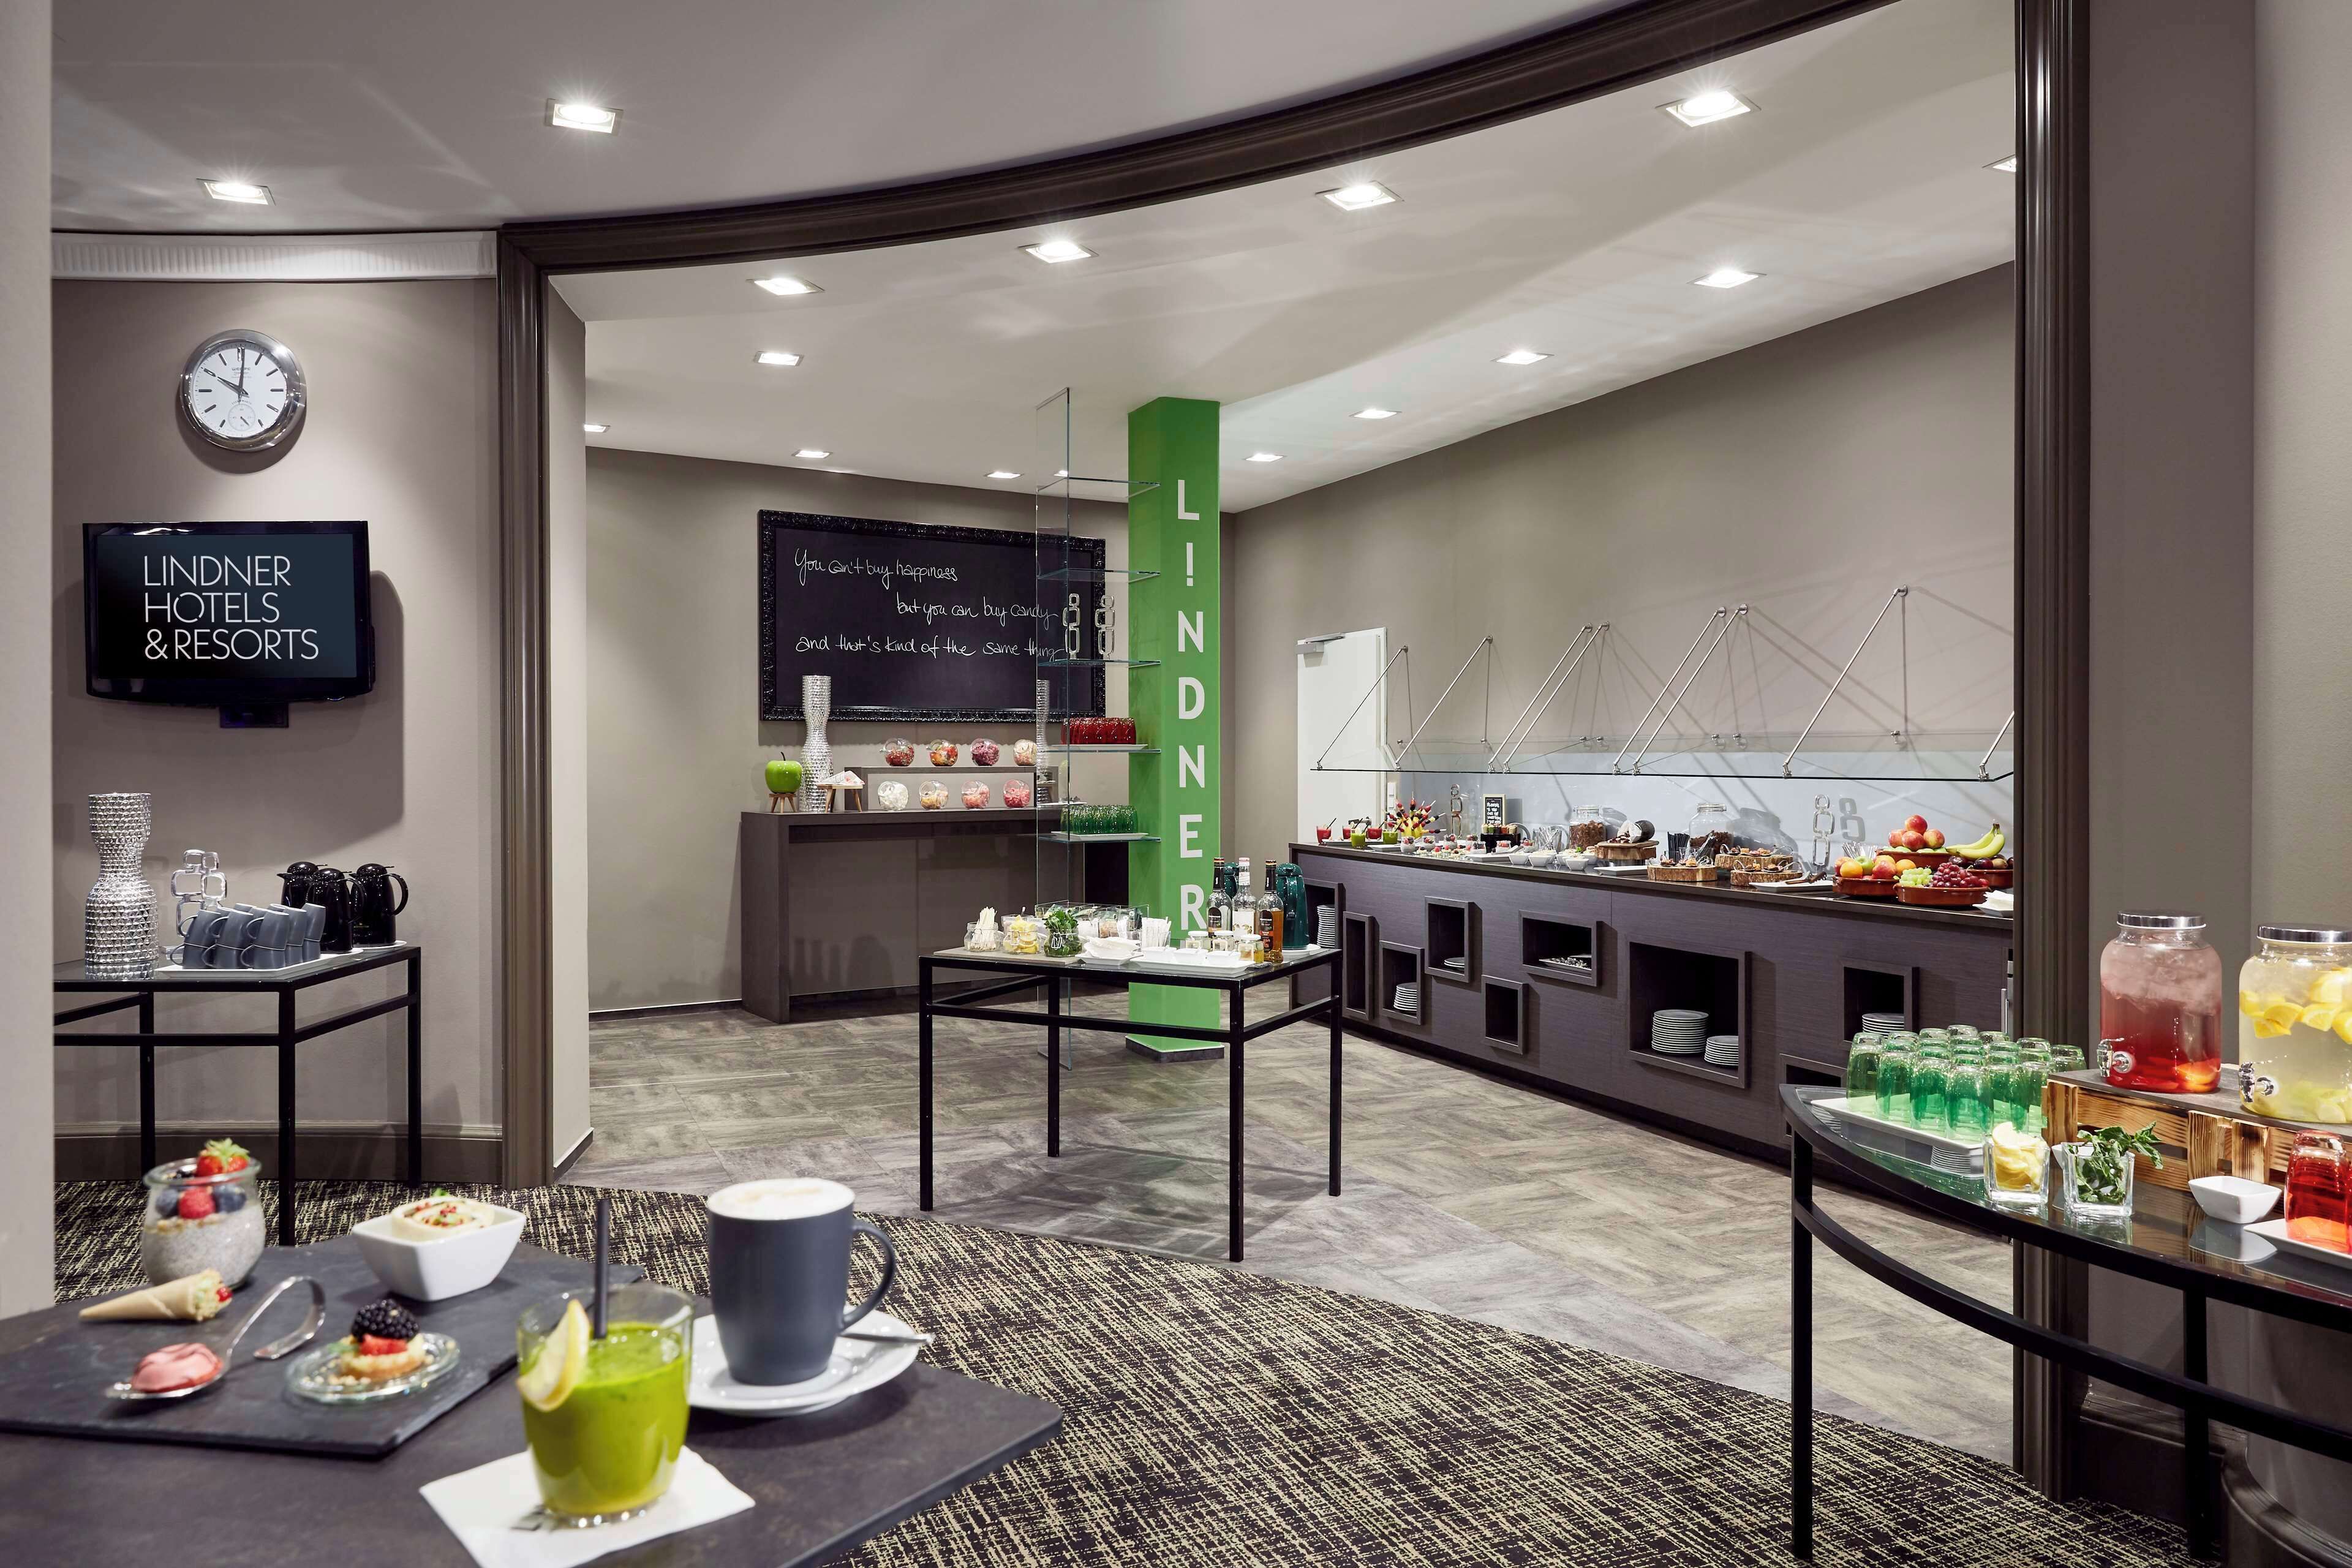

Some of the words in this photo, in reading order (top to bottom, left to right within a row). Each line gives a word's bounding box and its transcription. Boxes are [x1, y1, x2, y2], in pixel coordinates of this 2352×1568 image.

[144, 555, 292, 587] LINDNER
[794, 548, 826, 586] You
[828, 557, 864, 574] can't
[866, 559, 894, 590] buy
[896, 559, 958, 583] happiness
[145, 592, 280, 623] HOTELS
[896, 591, 921, 614] but
[922, 601, 948, 625] you
[951, 605, 979, 618] can
[983, 596, 1008, 627] buy
[1010, 603, 1059, 631] candy
[795, 635, 831, 652] and
[834, 633, 881, 653] that's
[884, 635, 918, 653] kind
[921, 635, 940, 660] of
[942, 636, 977, 657] the
[982, 641, 1021, 656] same
[1023, 637, 1065, 662] thing
